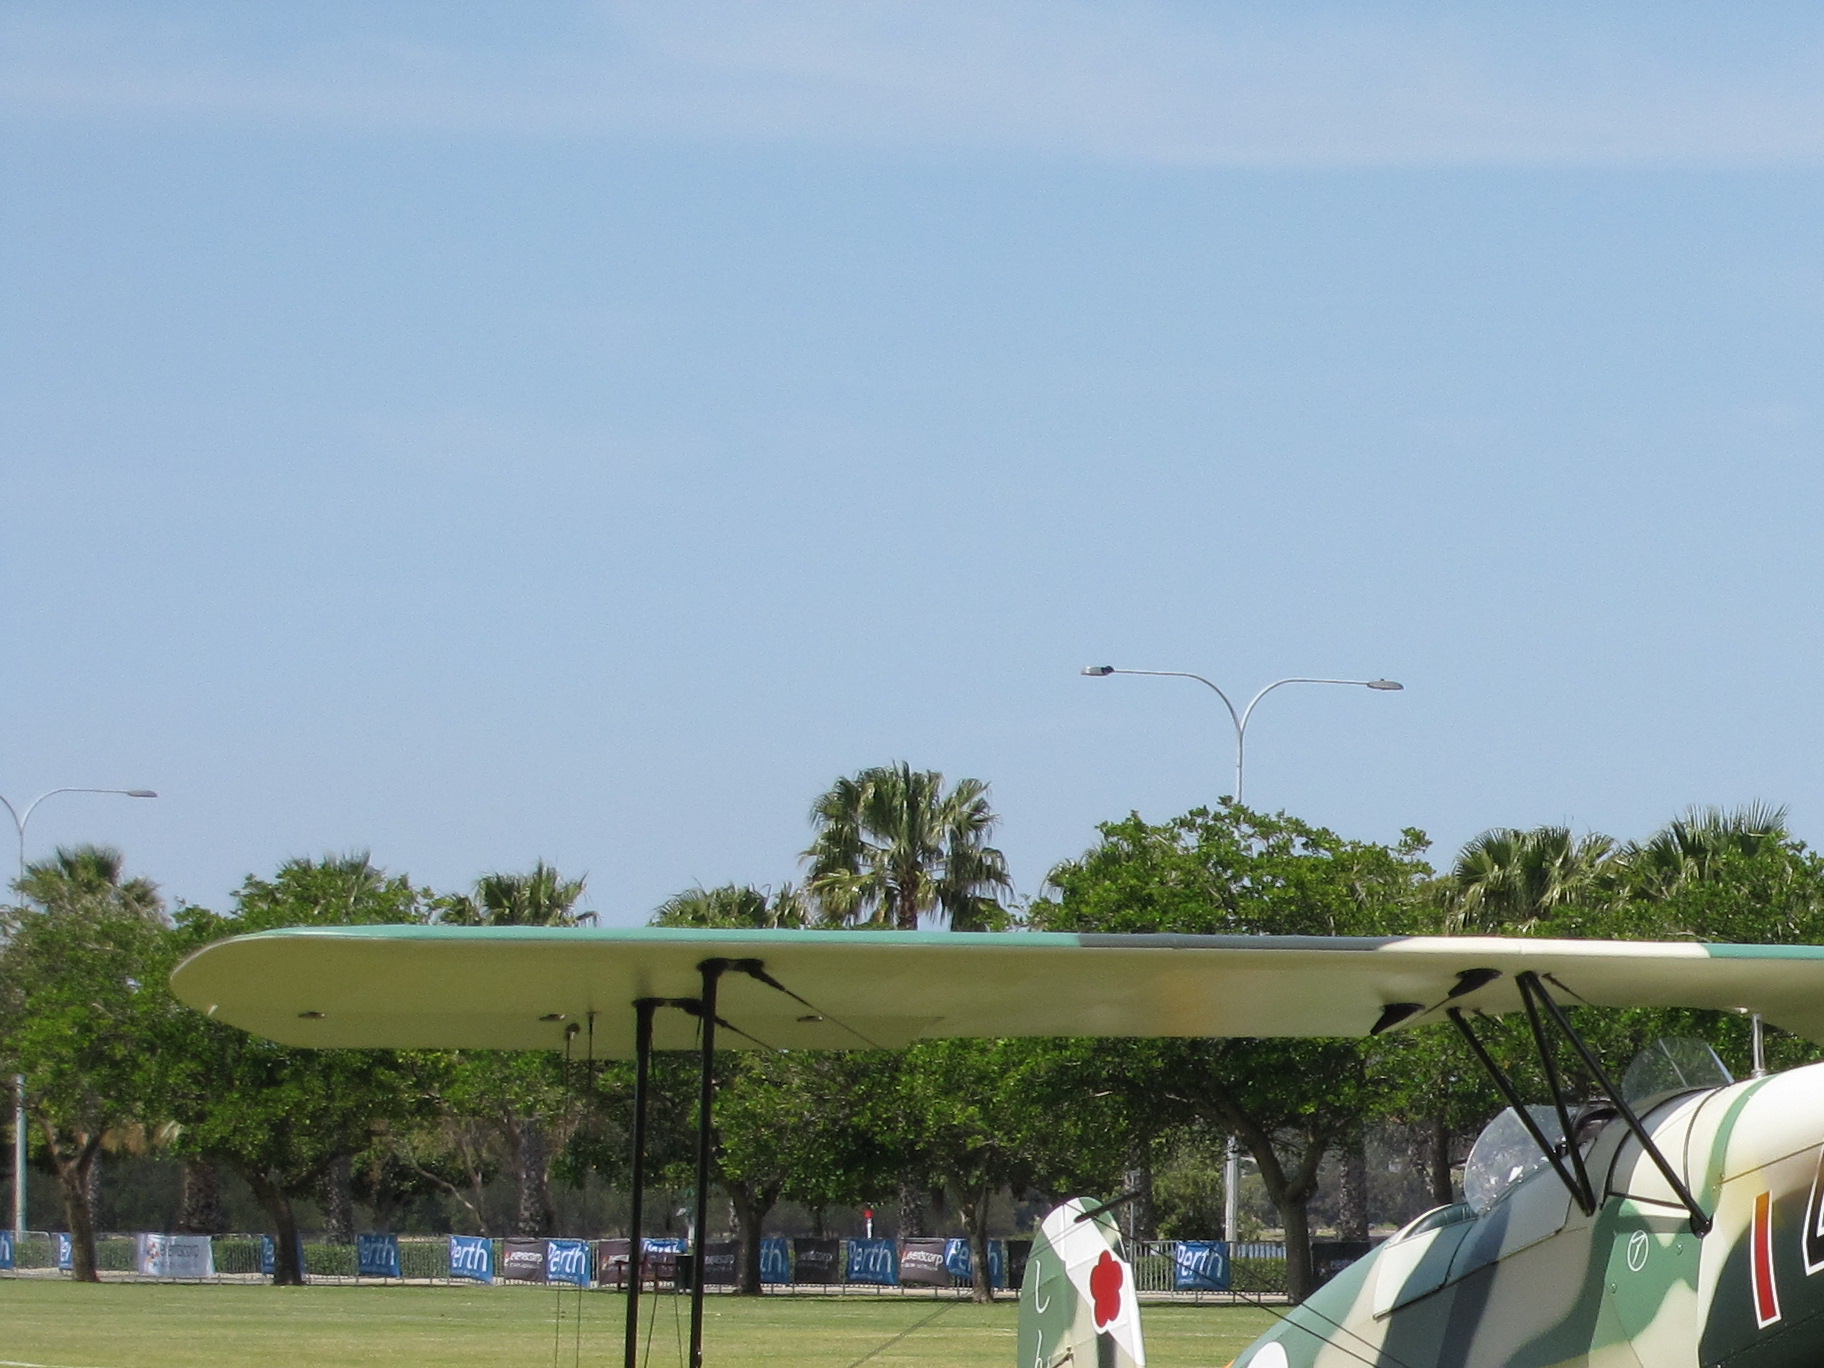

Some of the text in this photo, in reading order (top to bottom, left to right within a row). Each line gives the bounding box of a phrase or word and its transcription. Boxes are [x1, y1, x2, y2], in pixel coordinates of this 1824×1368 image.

[450, 1238, 488, 1272] Perth
[548, 1242, 586, 1275] Perth
[848, 1239, 891, 1273] Perth
[1176, 1242, 1222, 1277] Perth
